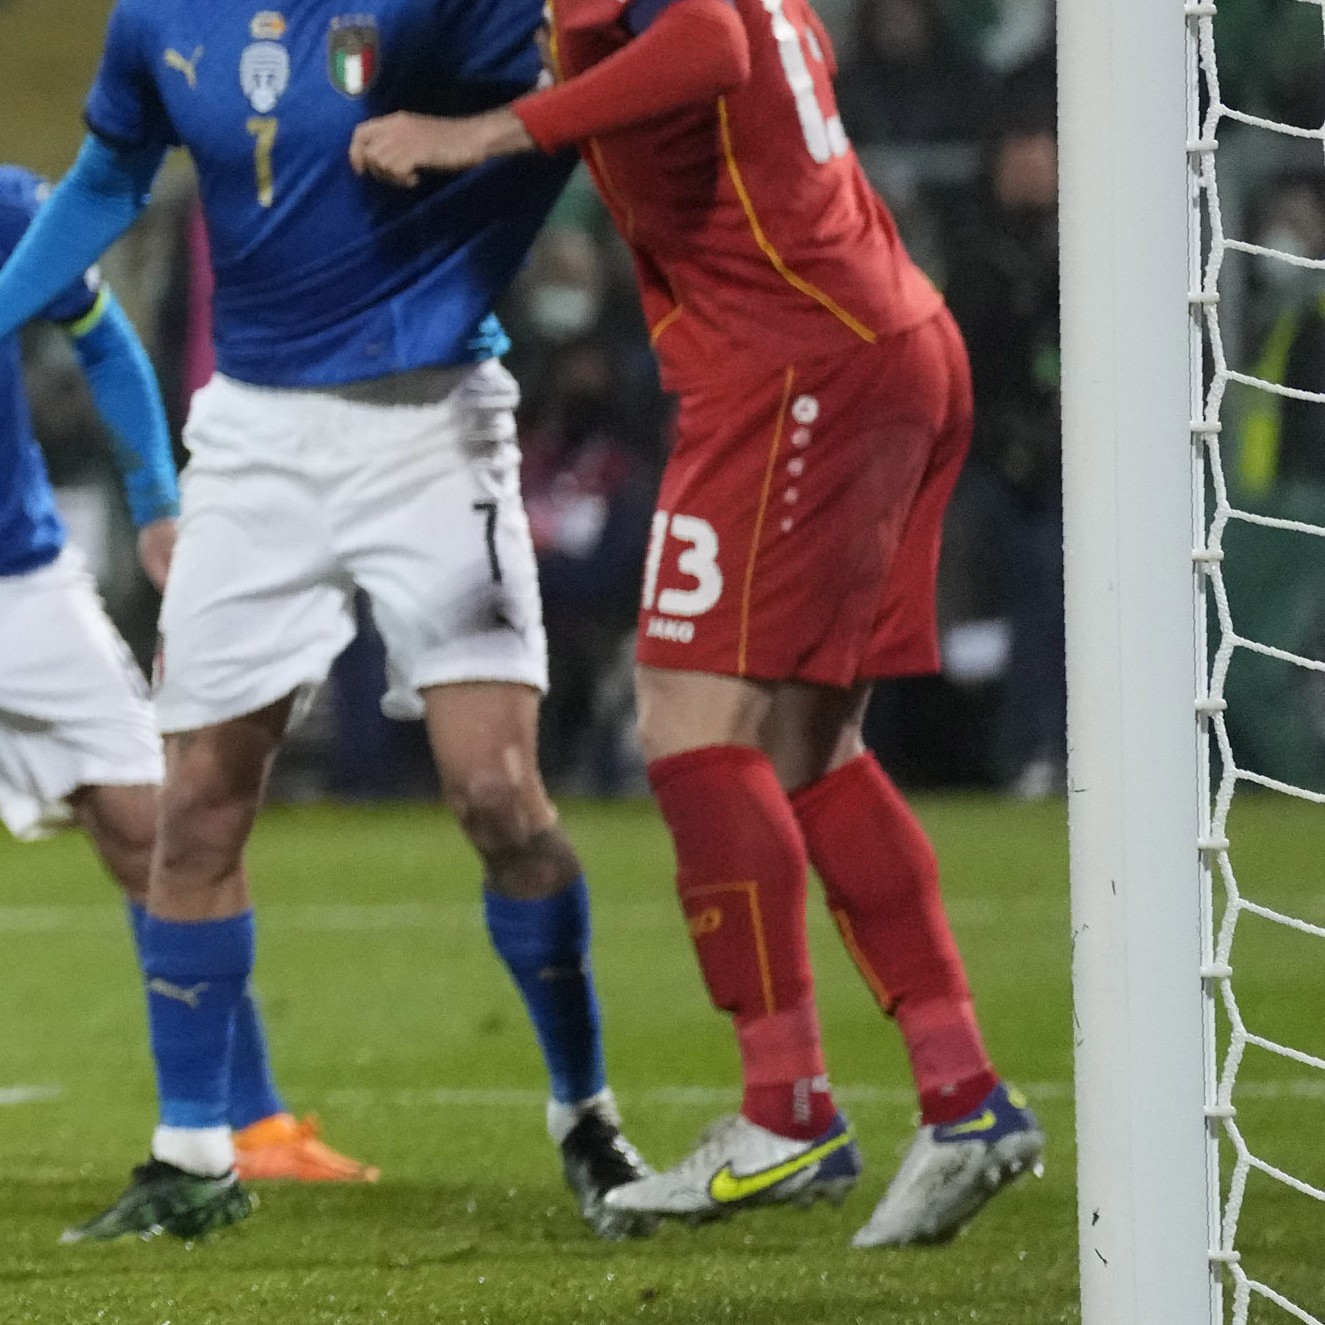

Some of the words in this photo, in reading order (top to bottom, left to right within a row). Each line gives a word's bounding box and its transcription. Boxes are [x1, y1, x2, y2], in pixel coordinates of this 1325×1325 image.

[245, 116, 278, 208] 7
[473, 500, 503, 586] 7
[642, 509, 724, 617] 13
